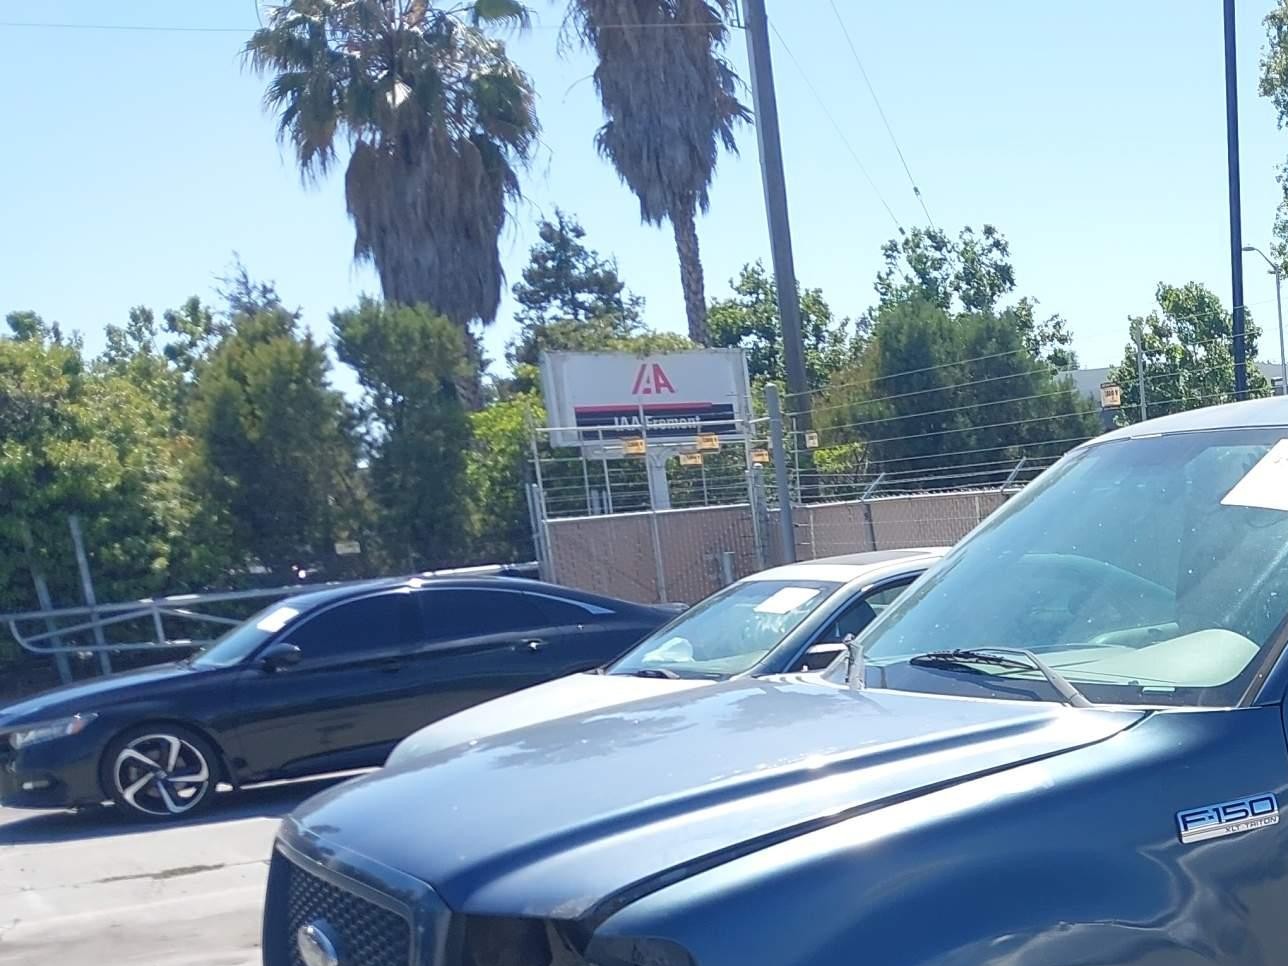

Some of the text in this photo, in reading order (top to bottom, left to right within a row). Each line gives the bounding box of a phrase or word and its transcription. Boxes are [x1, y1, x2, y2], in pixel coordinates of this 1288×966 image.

[614, 415, 701, 432] IAA Fremont
[1181, 796, 1275, 831] F-150
[1245, 816, 1277, 828] TRITON
